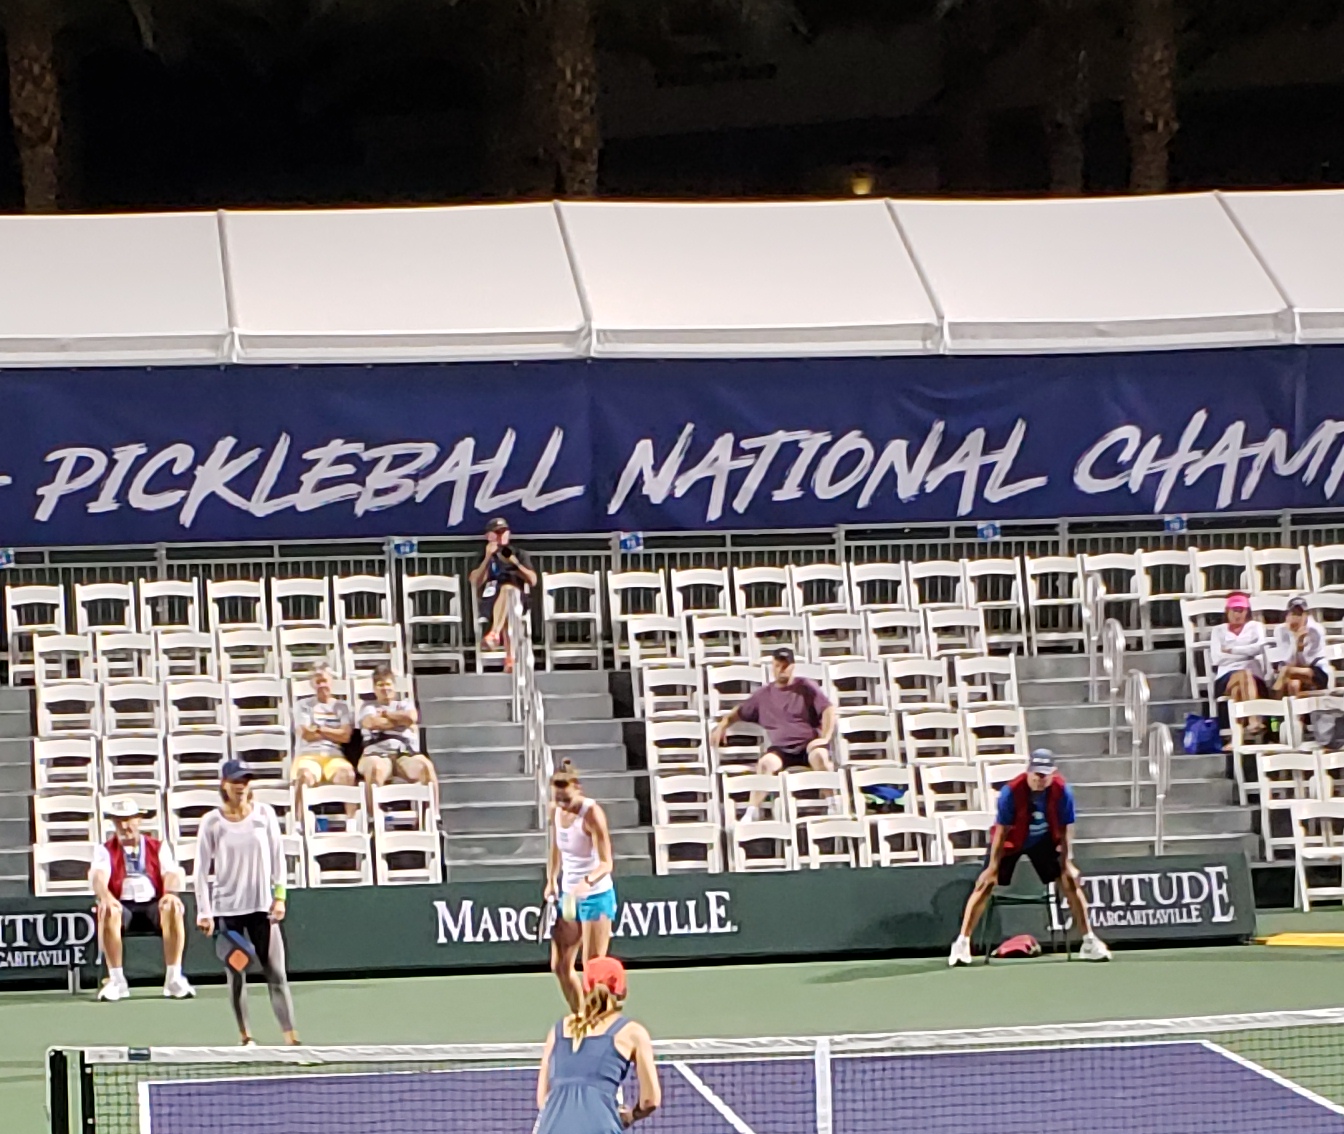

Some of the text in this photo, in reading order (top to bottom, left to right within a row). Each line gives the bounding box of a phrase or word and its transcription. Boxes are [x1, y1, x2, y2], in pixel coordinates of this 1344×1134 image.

[35, 427, 584, 527] PICKLEBALL
[608, 419, 1048, 527] NATIONAL
[1047, 865, 1235, 931] LTITUDE
